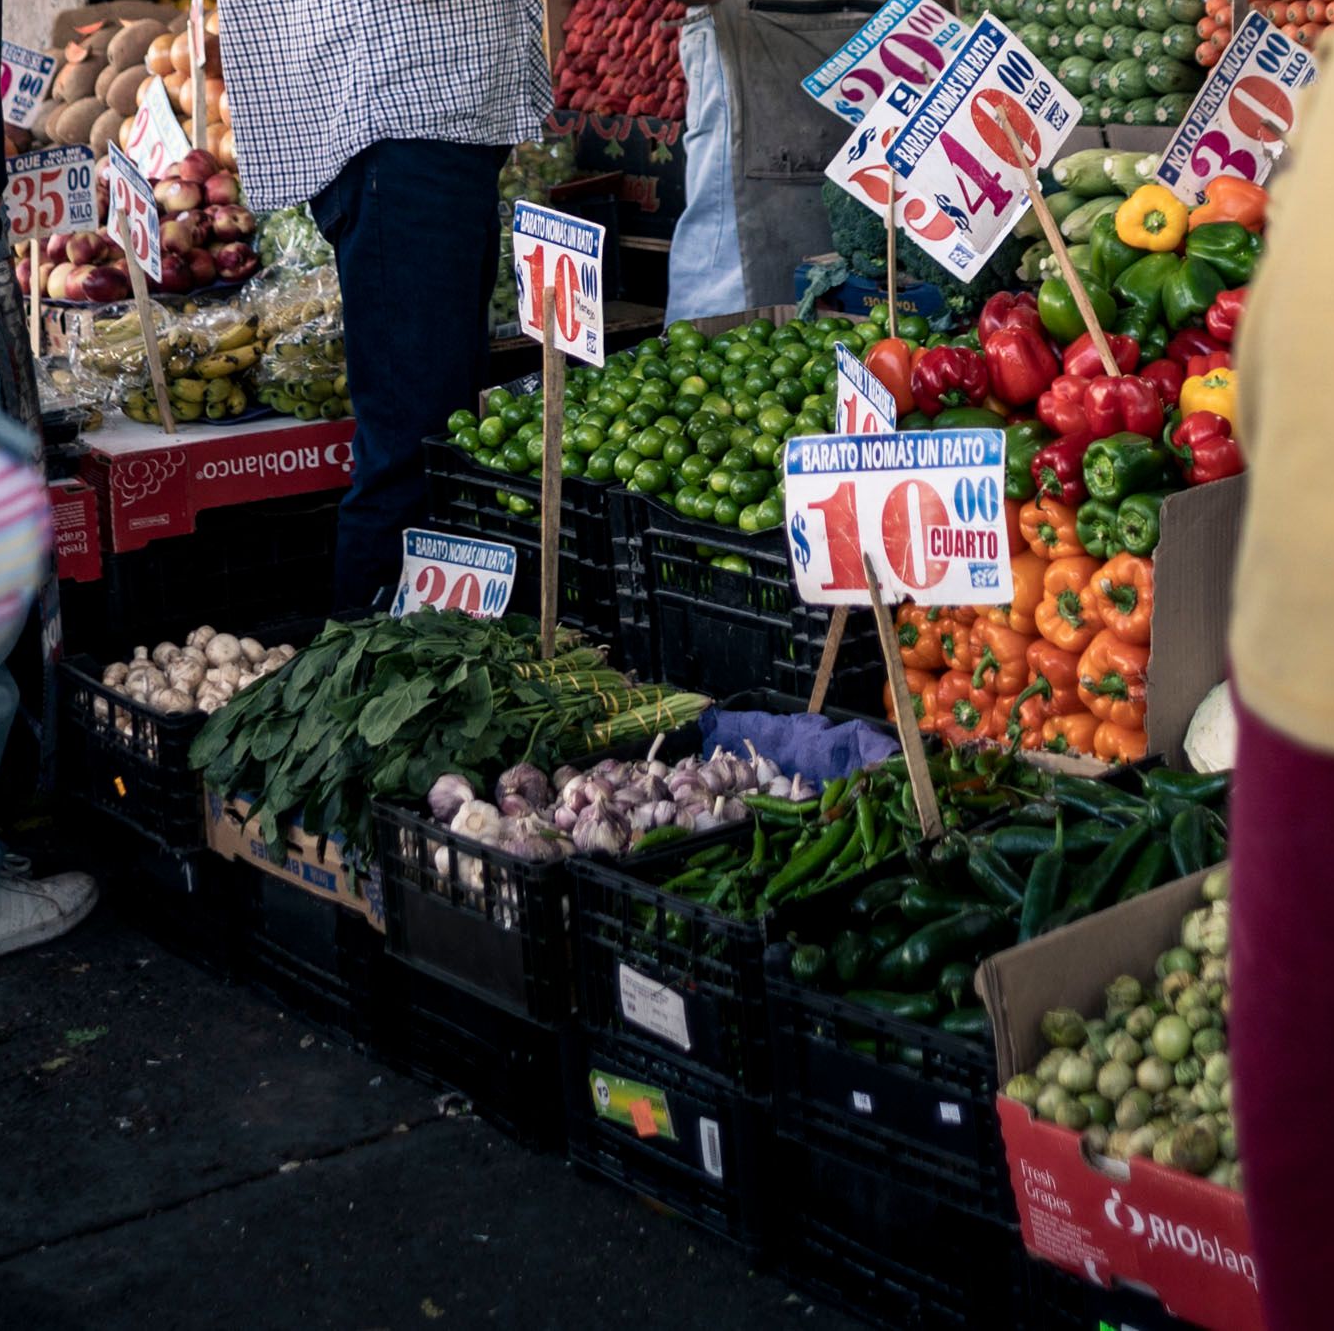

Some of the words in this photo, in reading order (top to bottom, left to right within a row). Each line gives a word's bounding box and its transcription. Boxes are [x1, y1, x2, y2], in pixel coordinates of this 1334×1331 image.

[907, 4, 946, 36] 00
[933, 23, 961, 48] KILO
[813, 50, 857, 87] HAGAN
[847, 38, 867, 58] SU
[861, 0, 906, 45] AGOSTO
[1255, 33, 1291, 74] 00
[996, 50, 1035, 95] 00
[1280, 52, 1308, 88] KILO
[894, 117, 940, 167] BARATO
[927, 80, 968, 125] NOMÁS
[956, 63, 978, 88] UN
[968, 33, 999, 71] RATO
[1025, 80, 1052, 115] KILO
[1167, 147, 1189, 172] NO
[1180, 125, 1202, 154] LO
[1194, 78, 1230, 129] PIENSE
[1222, 26, 1260, 82] MUCHO
[15, 153, 41, 171] QUE
[11, 168, 65, 235] 35
[68, 165, 91, 191] 00
[69, 203, 92, 220] KILO
[520, 210, 546, 239] BARATO
[546, 219, 567, 246] NOMÁS
[567, 228, 576, 248] UN
[578, 230, 594, 255] RATO
[581, 261, 598, 303] 00
[801, 442, 859, 472] BARATO
[861, 434, 915, 469] NOMÁS
[917, 439, 940, 467] UN
[942, 436, 985, 466] RATO
[953, 476, 1000, 524] 00
[58, 541, 89, 557] Fresh
[415, 536, 448, 560] BARATO
[449, 541, 476, 566] NOMÁS
[474, 549, 487, 567] UN
[487, 550, 508, 572] RATO
[930, 527, 999, 560] CUARTO
[483, 578, 508, 613] 00
[1020, 1157, 1058, 1191] Fresh
[1024, 1179, 1073, 1216] Grapes
[1148, 1212, 1260, 1284] RIOblan
